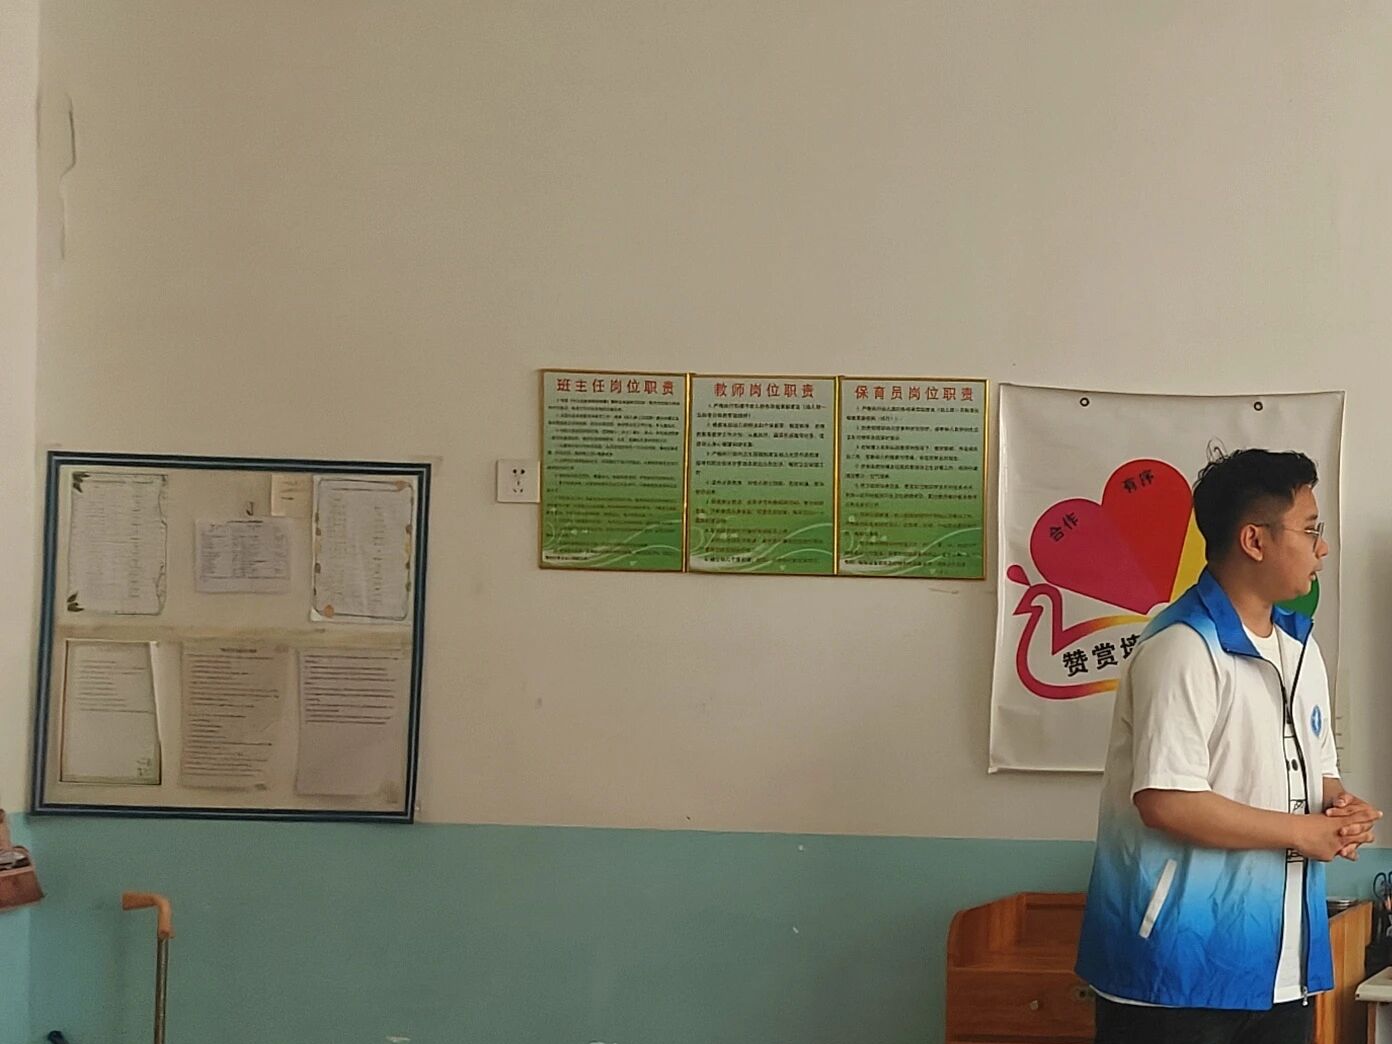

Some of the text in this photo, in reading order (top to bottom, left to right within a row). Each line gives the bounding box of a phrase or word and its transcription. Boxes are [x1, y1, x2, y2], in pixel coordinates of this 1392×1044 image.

[556, 378, 674, 396] 班主任岗位职责
[713, 382, 816, 399] 教师岗位职责
[855, 385, 974, 402] 保育员岗位职责
[1122, 469, 1154, 493] 有序
[1049, 512, 1078, 542] 合作
